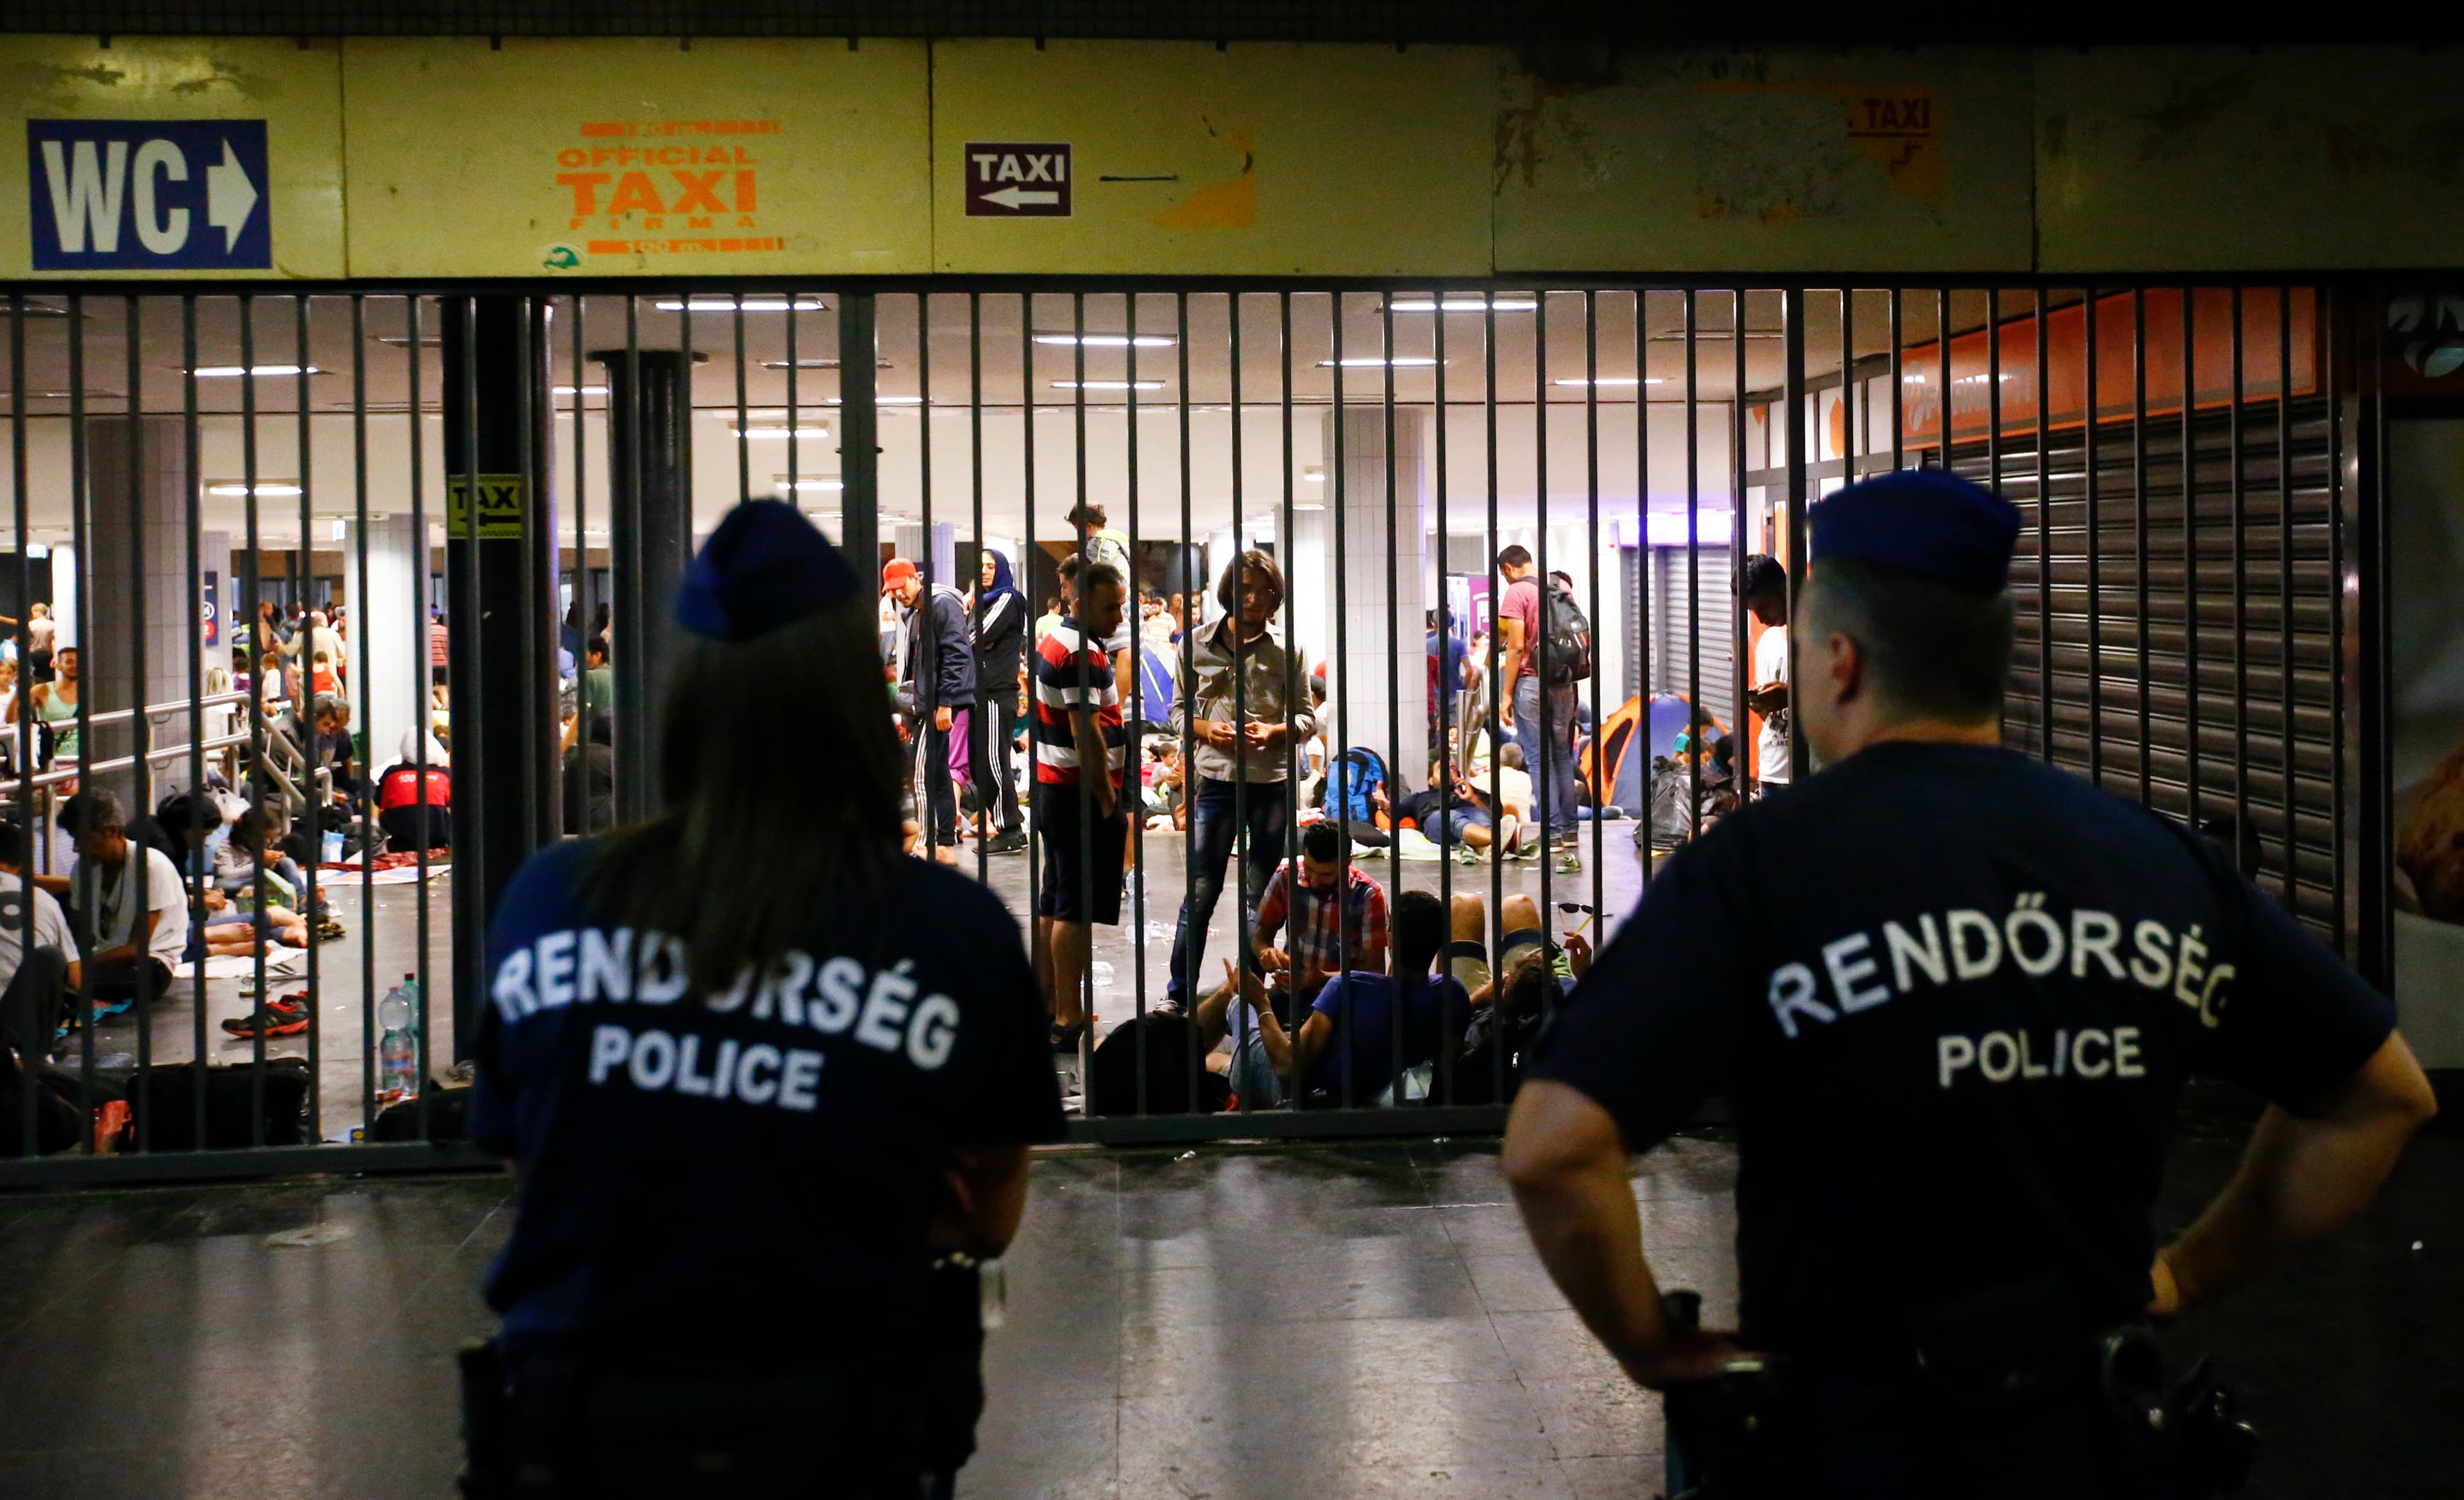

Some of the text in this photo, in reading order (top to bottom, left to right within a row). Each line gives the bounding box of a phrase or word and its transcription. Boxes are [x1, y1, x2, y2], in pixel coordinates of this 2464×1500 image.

[1863, 98, 1931, 129] TAXI
[557, 146, 760, 167] OFFICIAL
[971, 154, 1065, 182] TAXI
[41, 139, 190, 255] WC
[556, 169, 757, 216] TAXI
[453, 486, 516, 510] TAX
[588, 1024, 825, 1111] POLICE
[1937, 1027, 2146, 1089] POLICE
